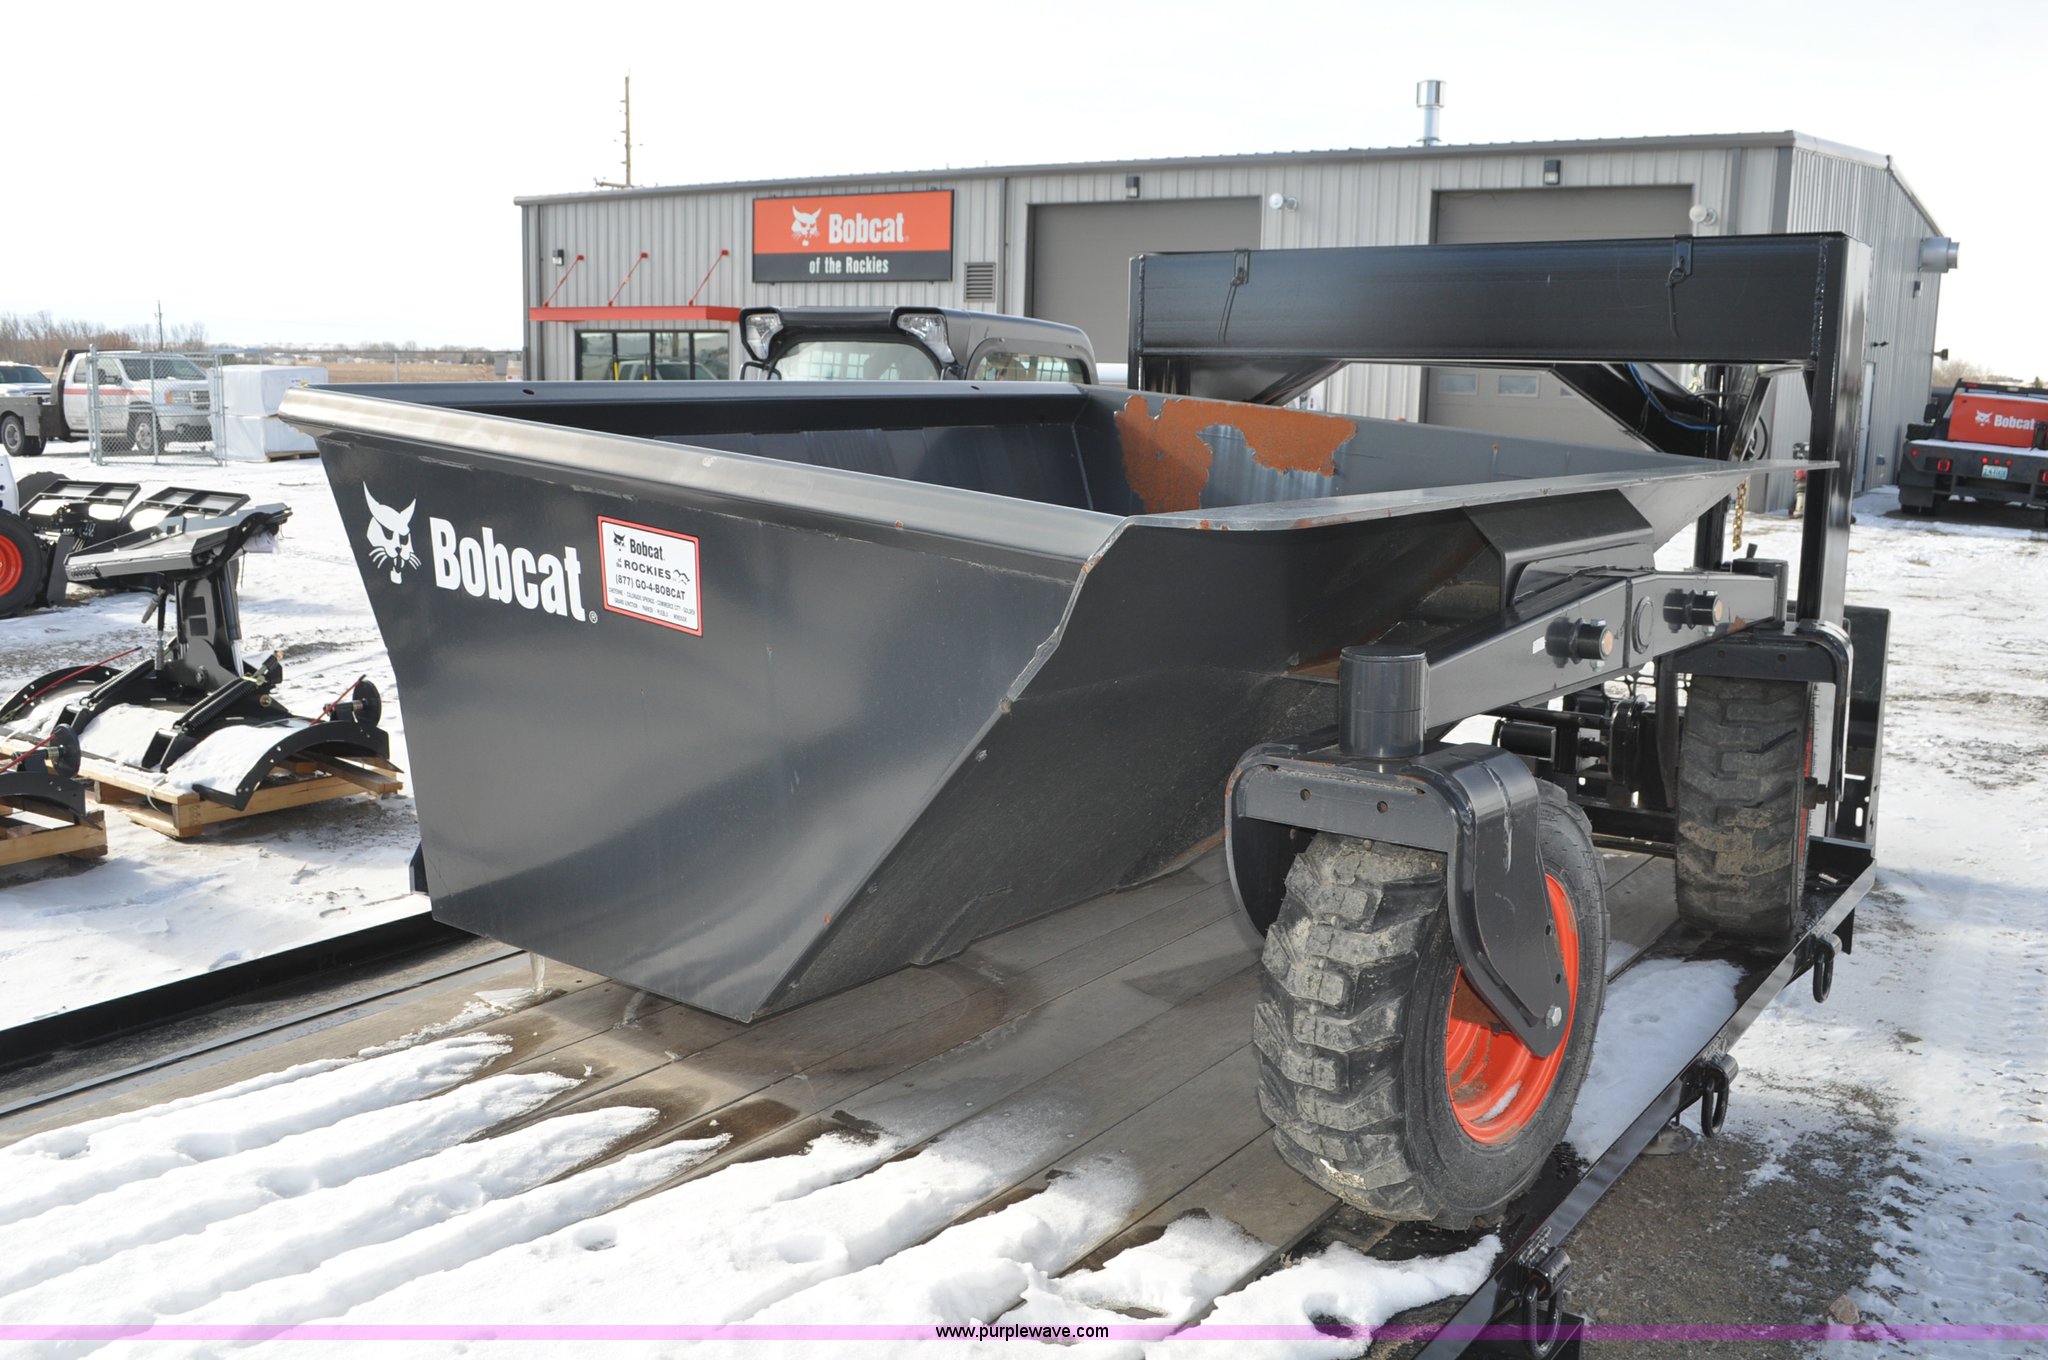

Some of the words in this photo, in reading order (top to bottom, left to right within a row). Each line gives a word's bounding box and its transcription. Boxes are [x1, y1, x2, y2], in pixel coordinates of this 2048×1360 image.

[828, 212, 905, 244] Bobcat
[809, 256, 820, 274] of
[824, 257, 842, 274] the
[845, 256, 889, 274] Rockies
[1994, 414, 2036, 430] Bobcat
[629, 538, 663, 561] Bobcat
[429, 516, 586, 622] Bobcat
[624, 559, 672, 580] ROCKIES
[615, 573, 634, 589] (877)
[635, 578, 686, 601] GO-4-BOBCAT
